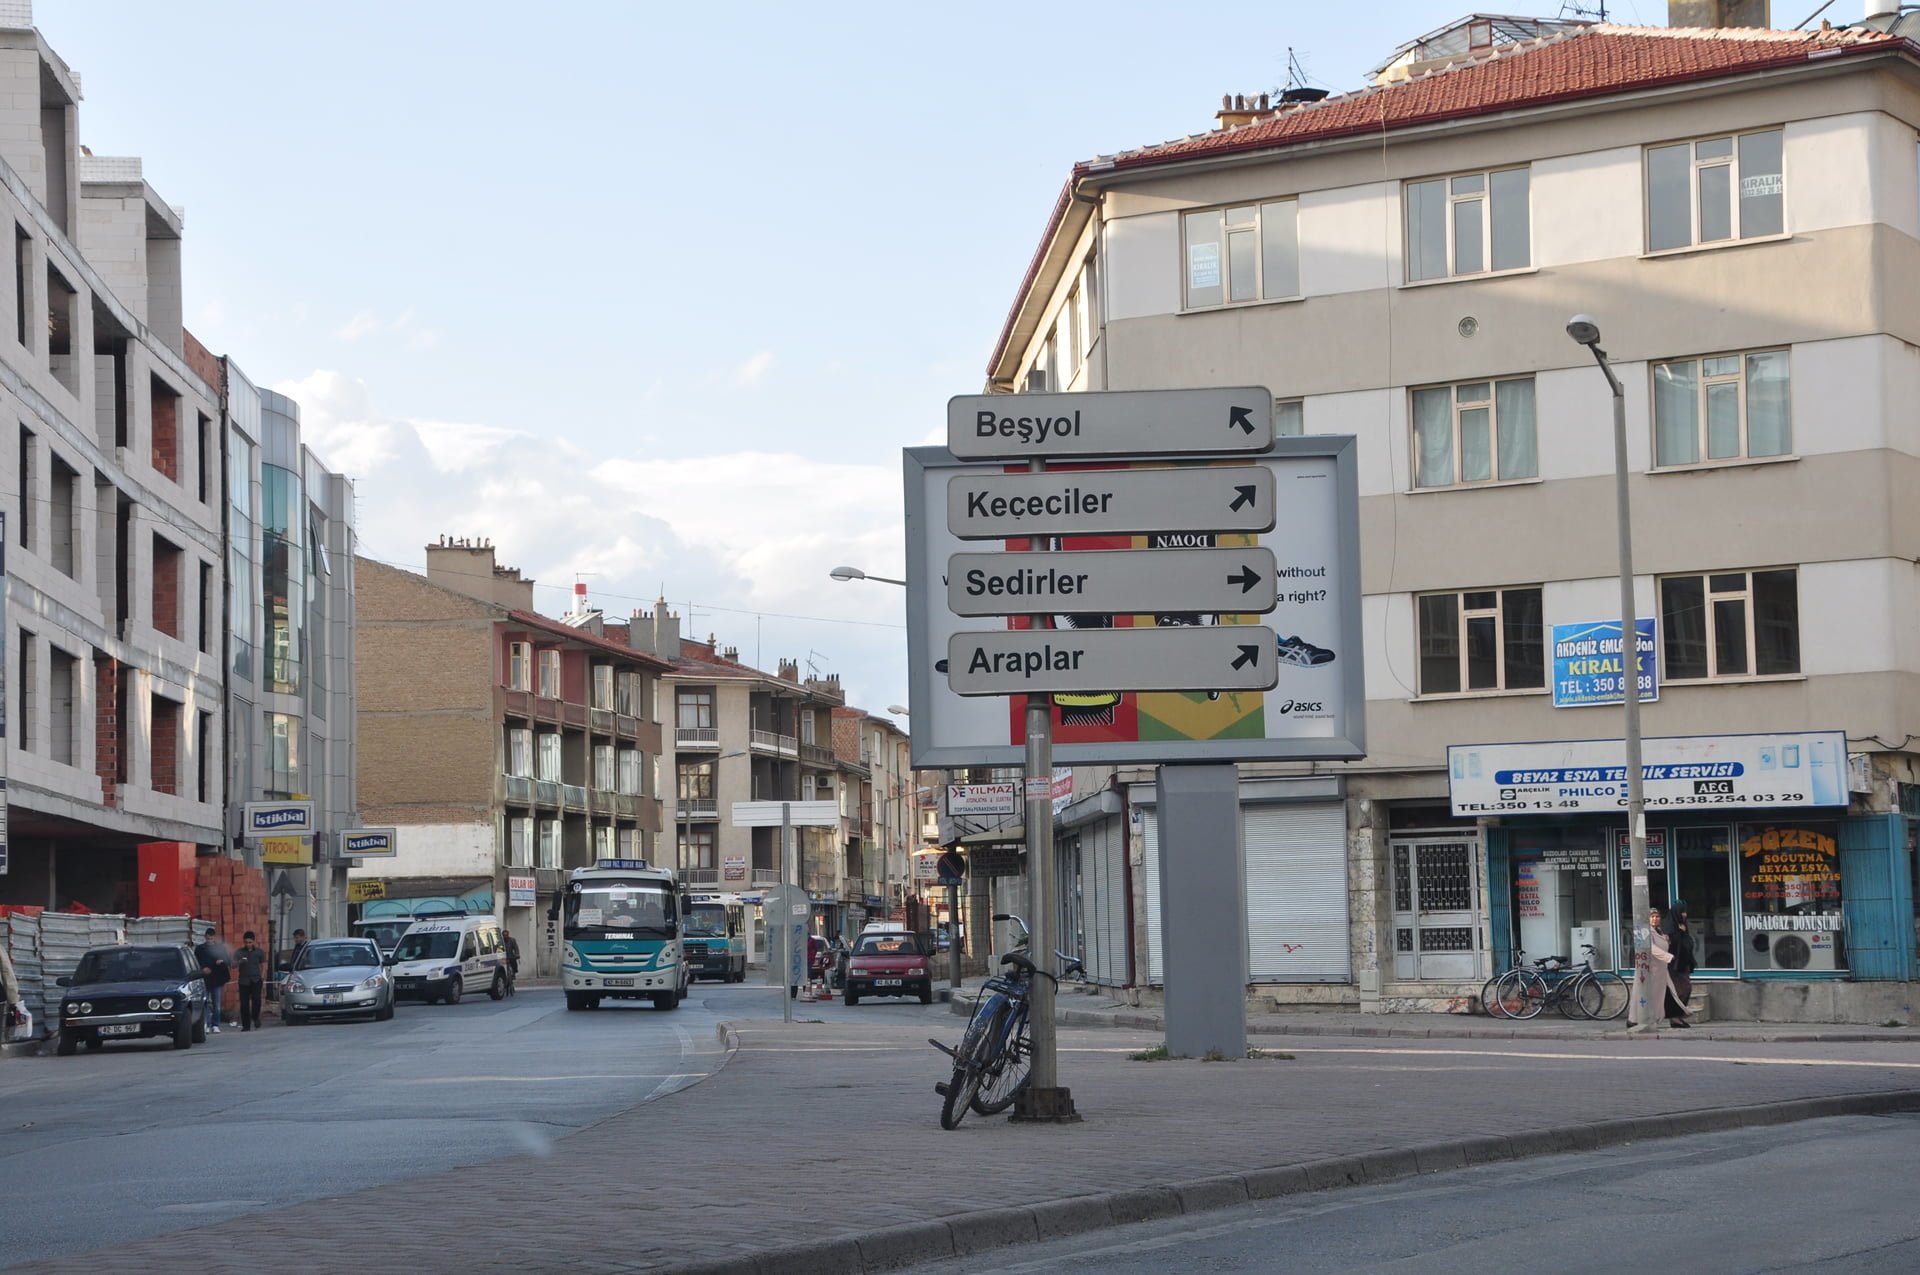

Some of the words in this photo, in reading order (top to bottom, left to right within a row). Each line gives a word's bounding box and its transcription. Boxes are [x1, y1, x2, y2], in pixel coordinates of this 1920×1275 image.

[976, 410, 1081, 443] Beşyol
[967, 489, 1112, 520] Keçeciler
[1156, 534, 1209, 548] DOWN
[1277, 566, 1326, 578] without
[966, 569, 1088, 596] Sedirler
[1277, 592, 1285, 602] a
[1288, 589, 1327, 604] right?
[1556, 636, 1598, 658] AKDENİZ
[968, 645, 1084, 679] Araplar
[1568, 656, 1644, 676] KİRALK
[1560, 680, 1583, 694] TEL
[1593, 677, 1614, 692] 350
[1512, 772, 1559, 784] BEYAZ
[1563, 770, 1600, 783] EŞYA
[1605, 765, 1666, 780] TENİK
[1669, 762, 1735, 778] SERVİSİ
[968, 785, 1012, 795] YILMAZ
[1559, 787, 1615, 797] PHILCO
[1698, 781, 1729, 793] AEG
[1458, 801, 1527, 811] TEL:350
[1531, 800, 1553, 809] 13
[1558, 799, 1580, 808] 48
[1617, 795, 1747, 806] CP:0.538.254
[1752, 794, 1775, 802] 03
[1782, 793, 1804, 801] 29
[255, 812, 304, 825] istikbal
[348, 837, 387, 848] istikbal
[1759, 864, 1798, 873] BEYAZ
[1744, 913, 1790, 931] DOĞALGAZ
[1793, 911, 1841, 933] DÖNÜŞÜMÜ
